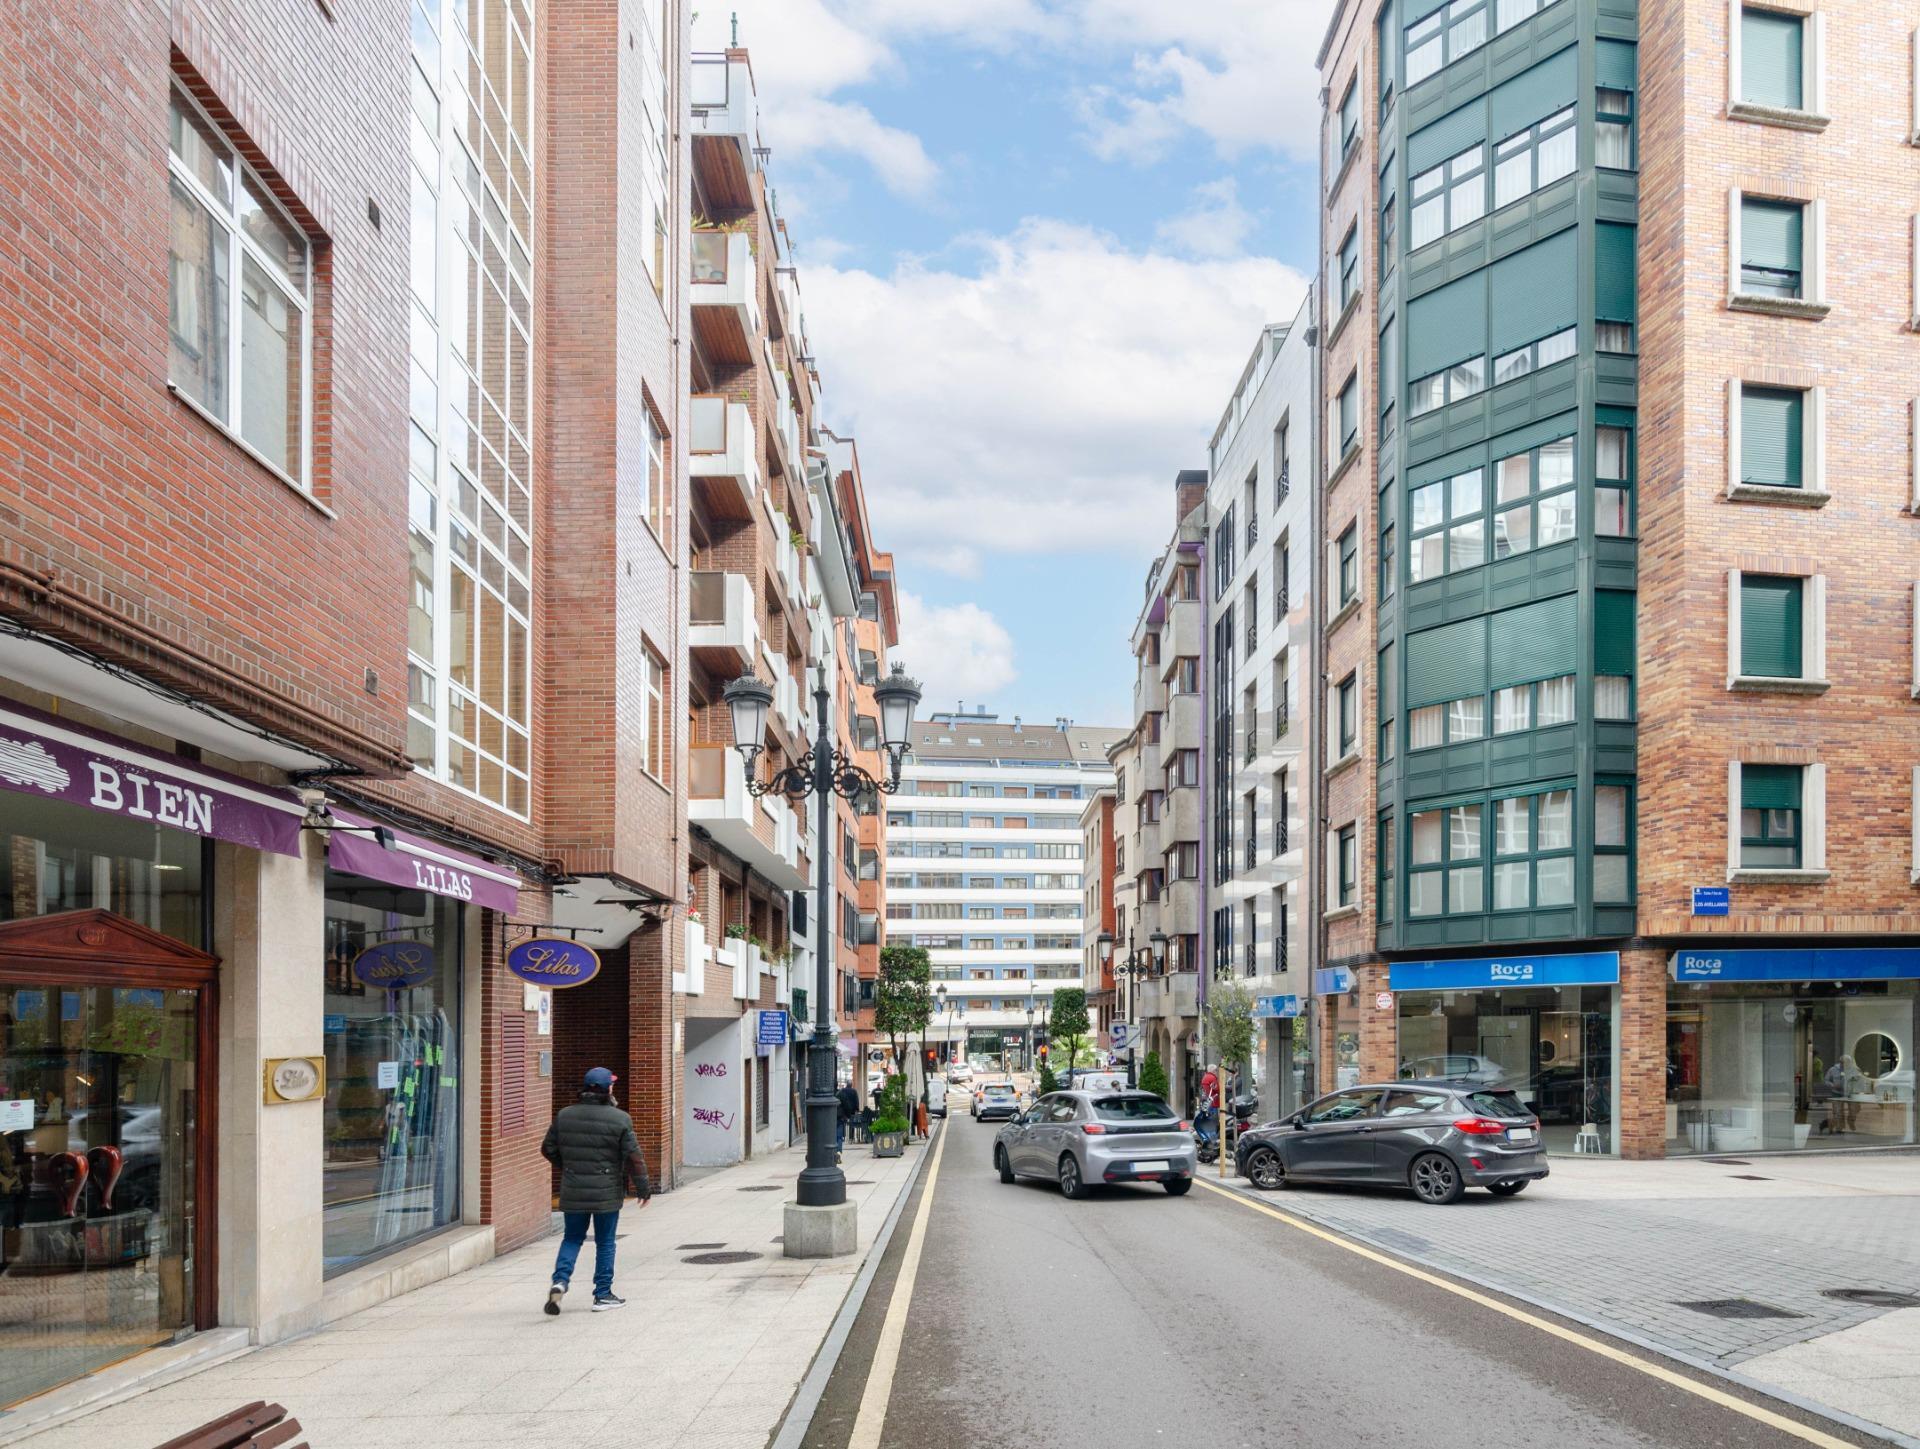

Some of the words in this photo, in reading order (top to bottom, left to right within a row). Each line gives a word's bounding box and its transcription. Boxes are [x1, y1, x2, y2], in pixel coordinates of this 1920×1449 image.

[88, 761, 213, 833] BIEN
[412, 860, 472, 900] LILAS
[522, 947, 581, 976] Lilas
[1490, 963, 1534, 975] Roca
[1685, 956, 1722, 969] Roca
